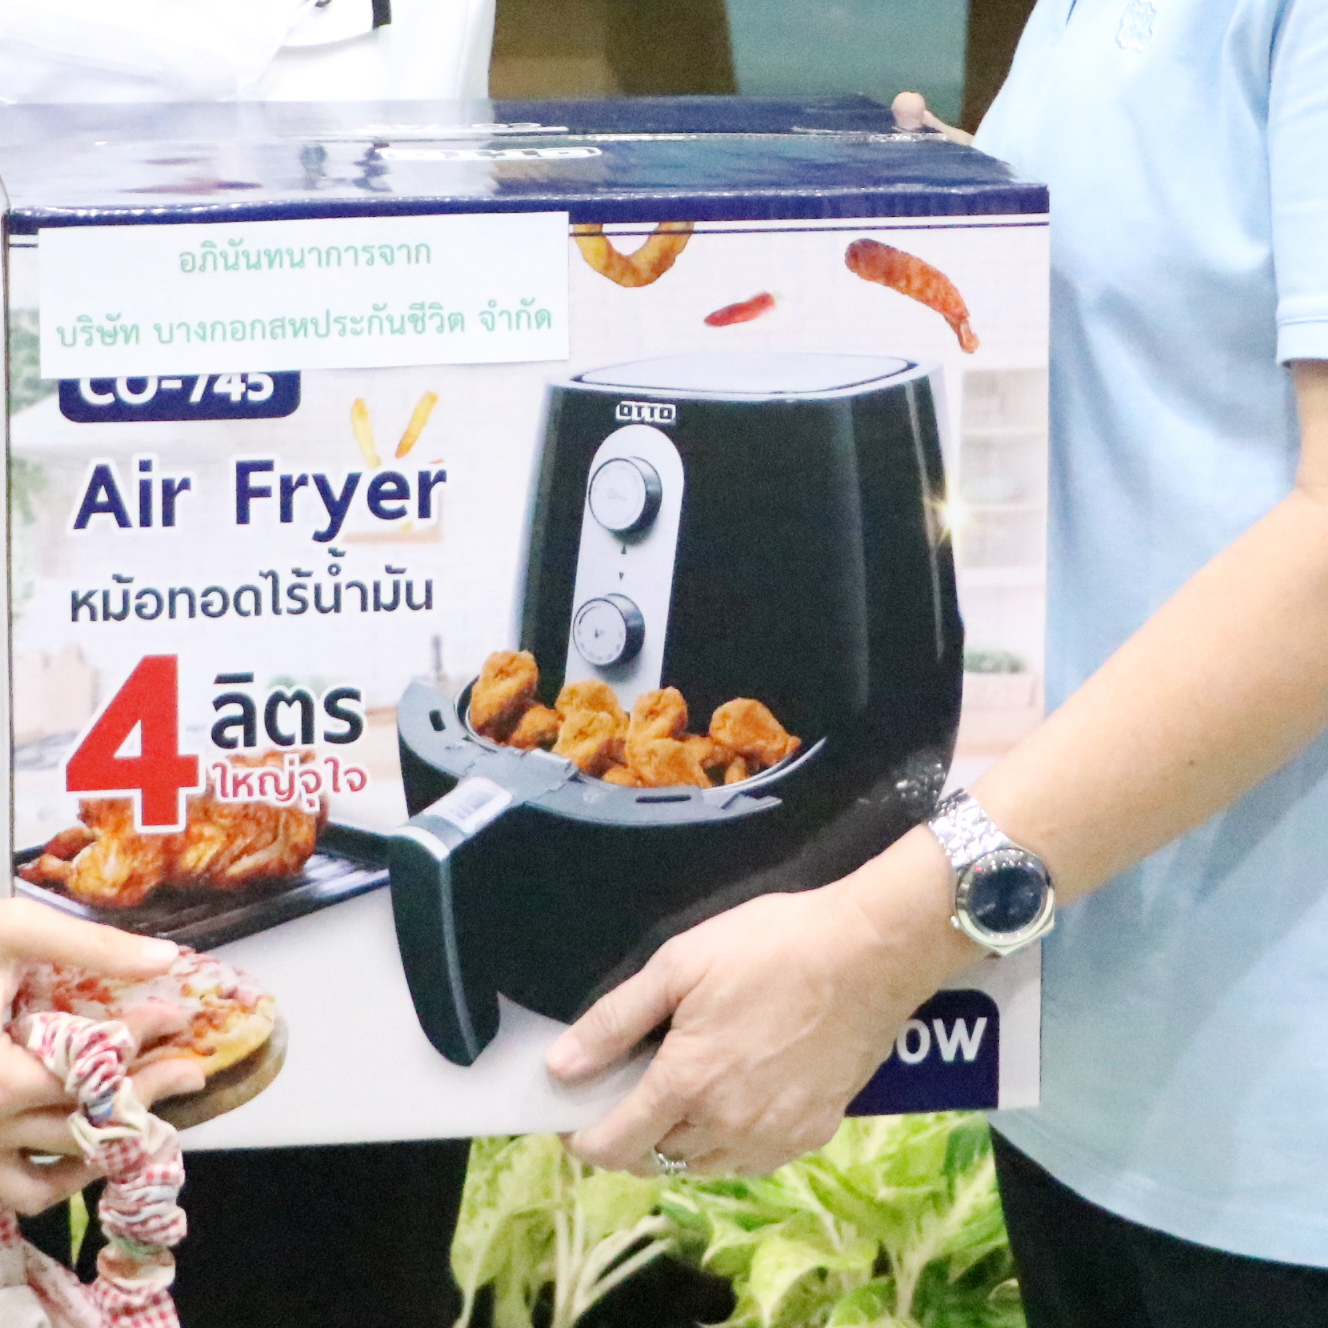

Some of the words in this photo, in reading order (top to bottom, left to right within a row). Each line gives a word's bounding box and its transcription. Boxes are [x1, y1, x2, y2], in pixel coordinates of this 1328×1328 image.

[178, 239, 432, 274] อภินันทนาการจาก
[56, 312, 141, 349] บริษัท
[153, 301, 465, 344] บางกอกสหประกันชีวิต
[478, 297, 553, 334] จำกัด
[616, 401, 676, 422] OTTO
[72, 459, 191, 530] Air
[235, 460, 447, 543] Fryer
[71, 547, 434, 623] หม้อทอดไร้น้ำมัน
[65, 653, 199, 827] 4
[210, 672, 366, 749] ลิตร
[896, 1017, 988, 1065] 0W
